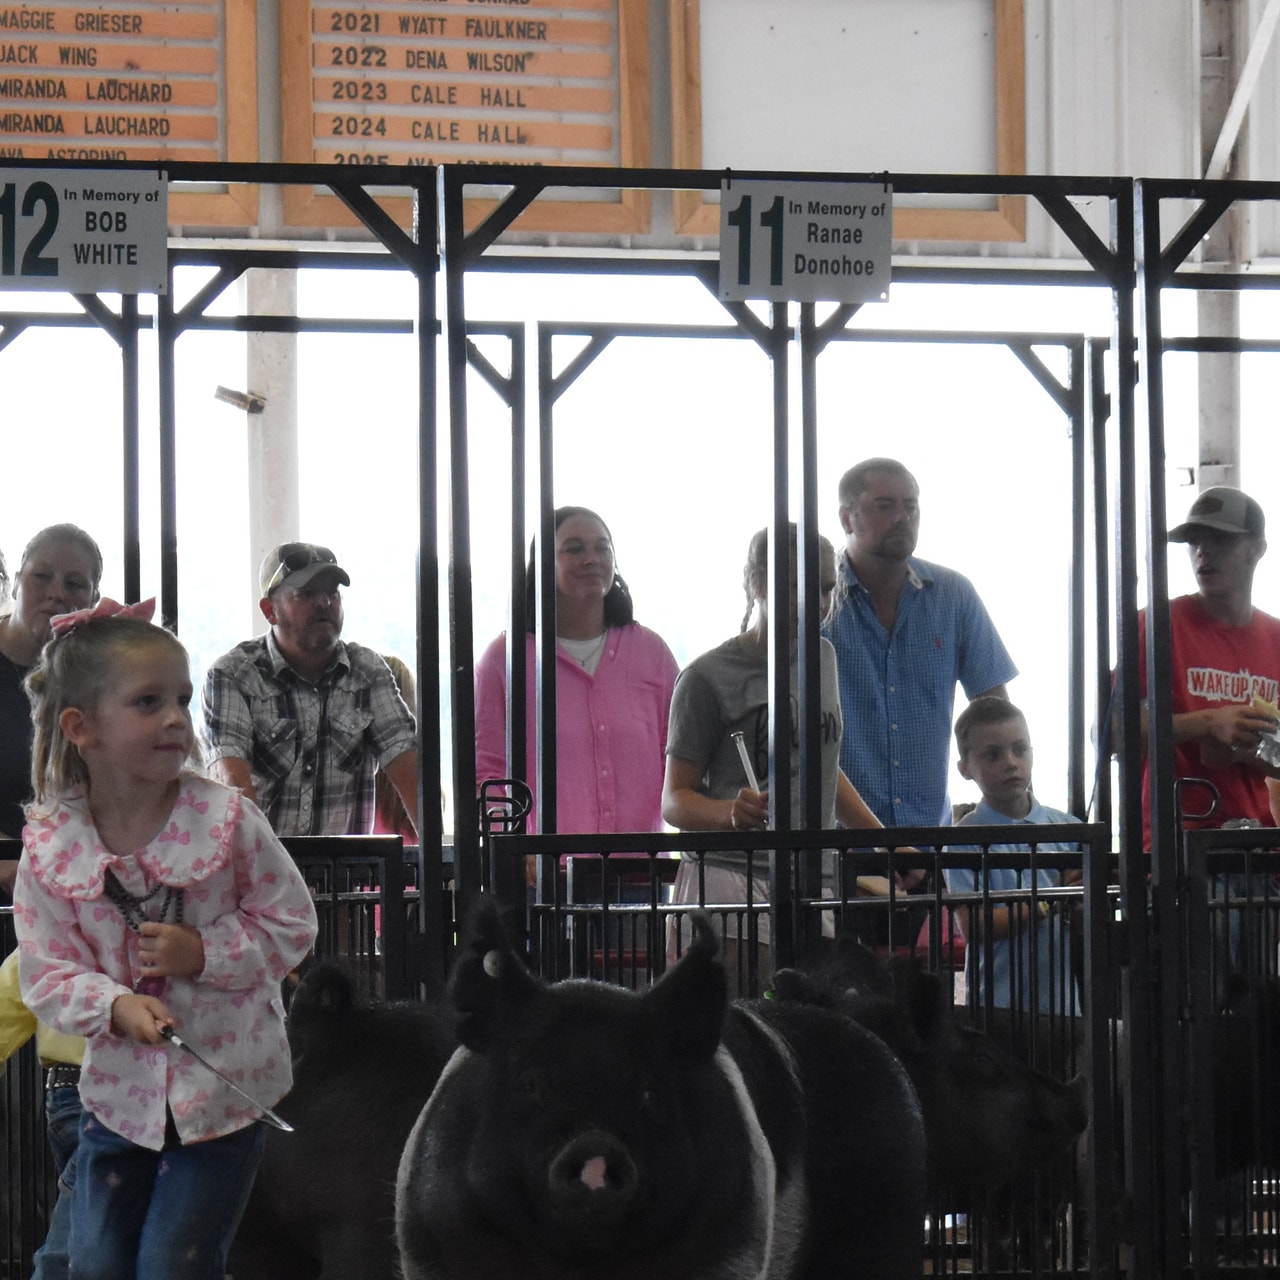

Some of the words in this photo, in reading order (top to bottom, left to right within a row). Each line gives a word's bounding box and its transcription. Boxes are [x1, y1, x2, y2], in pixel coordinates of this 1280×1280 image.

[75, 13, 142, 33] GRIESER
[331, 13, 380, 32] 2021
[399, 16, 447, 35] WYATT
[466, 19, 547, 40] FAULKNER
[59, 46, 97, 66] WING
[331, 47, 387, 67] 2022
[406, 50, 447, 70] DENA
[467, 52, 526, 72] WILSON
[86, 81, 172, 102] LAUCHARD
[332, 82, 388, 100] 2023
[411, 85, 457, 104] CALE
[481, 87, 526, 108] HALL
[84, 117, 170, 137] LAUCHARD
[332, 117, 387, 136] 2024
[412, 121, 459, 141] CALE
[478, 123, 526, 144] HALL
[64, 189, 77, 200] In
[82, 189, 140, 204] Memory
[145, 190, 159, 202] of
[789, 201, 802, 214] In
[808, 201, 866, 219] Memory
[871, 203, 886, 216] of
[85, 211, 127, 232] BOB
[728, 195, 784, 286] 11
[807, 222, 863, 244] Ranae
[74, 243, 138, 265] WHITE
[794, 253, 874, 275] Donohoe
[1191, 671, 1229, 696] WAKE
[1231, 676, 1249, 698] UP
